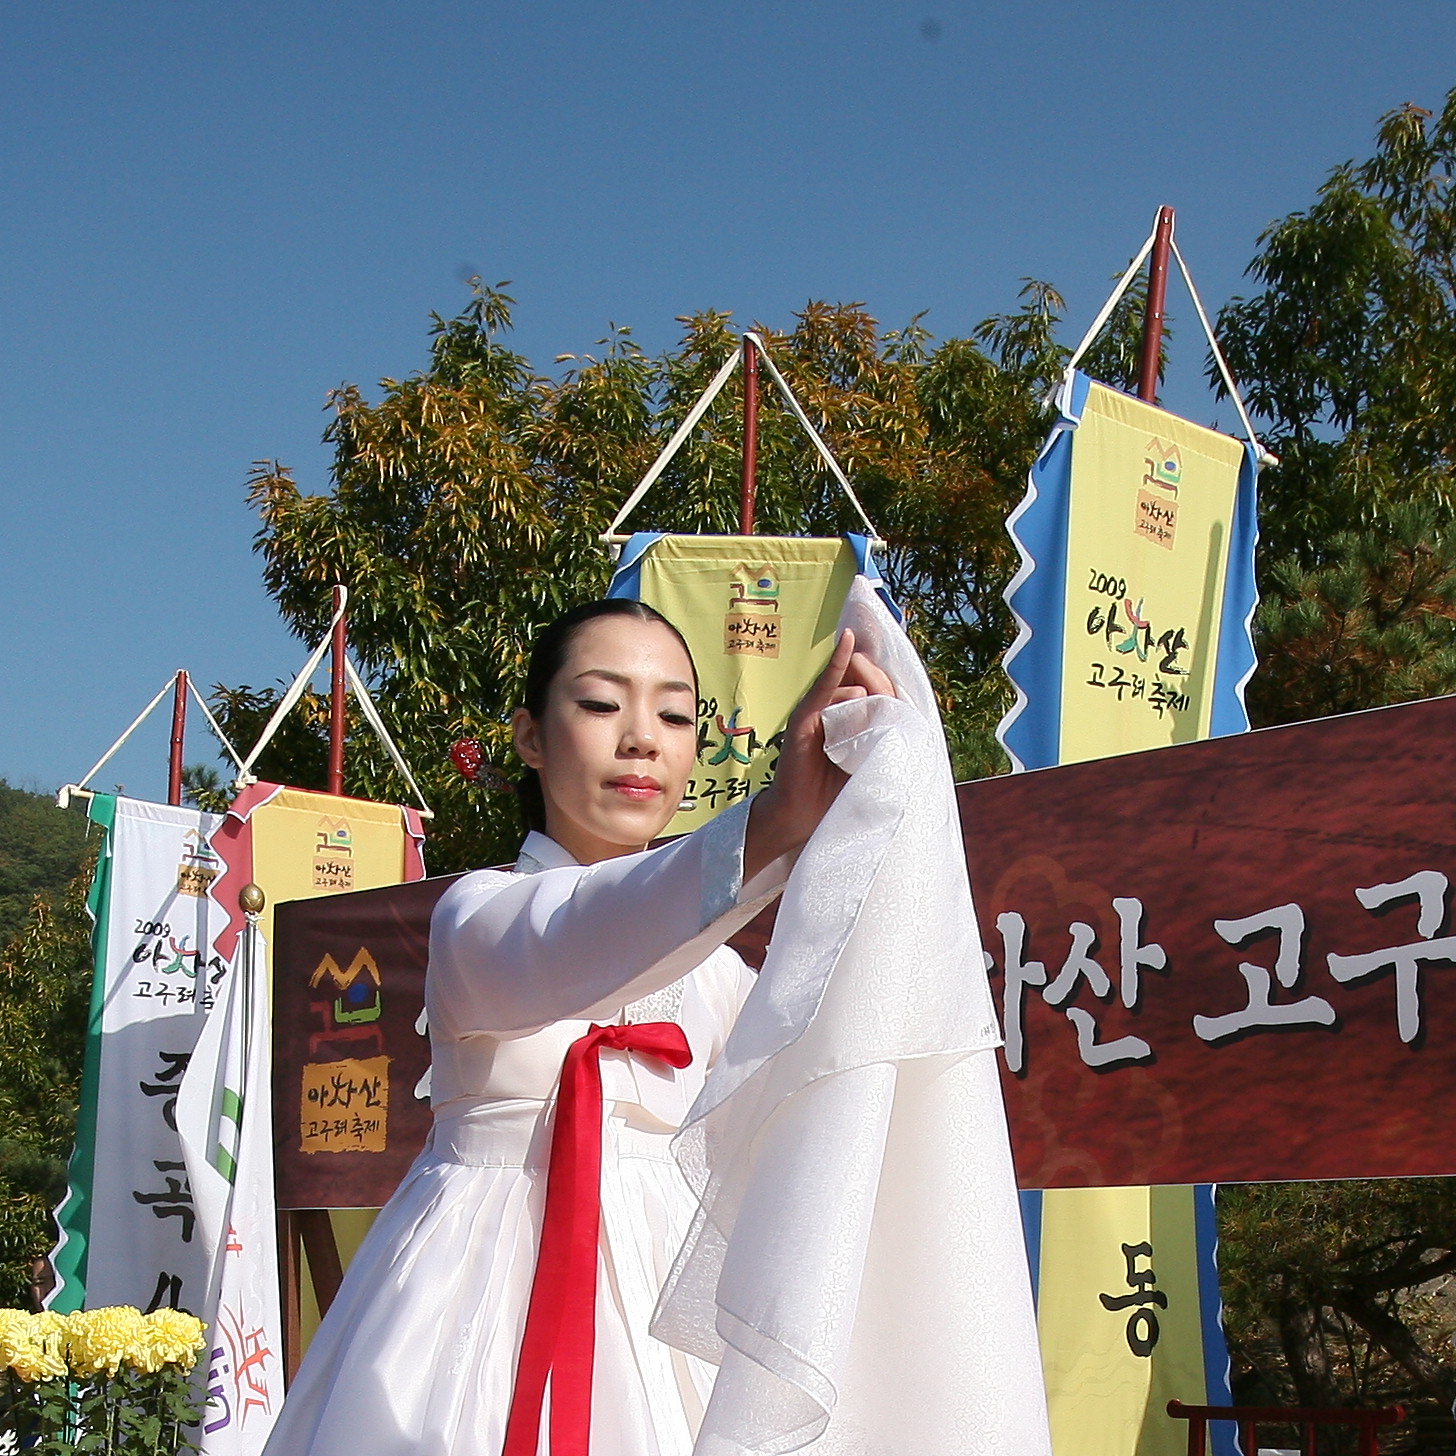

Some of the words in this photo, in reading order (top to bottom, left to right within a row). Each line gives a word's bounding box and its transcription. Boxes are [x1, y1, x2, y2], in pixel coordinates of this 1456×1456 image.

[1140, 500, 1174, 528] 아차산
[1087, 568, 1127, 600] 2009
[727, 617, 777, 638] 아차산
[1086, 597, 1191, 675] 아차산
[1086, 662, 1146, 702] 고구려
[1148, 673, 1191, 720] 축제
[697, 697, 718, 718] 09
[315, 860, 352, 878] 아차산
[134, 919, 171, 938] 2009
[132, 981, 196, 1006] 고구려
[306, 1070, 382, 1110] 아차산
[305, 1118, 348, 1143] 고구려
[350, 1112, 381, 1143] 축제
[1098, 1240, 1168, 1358] 동
